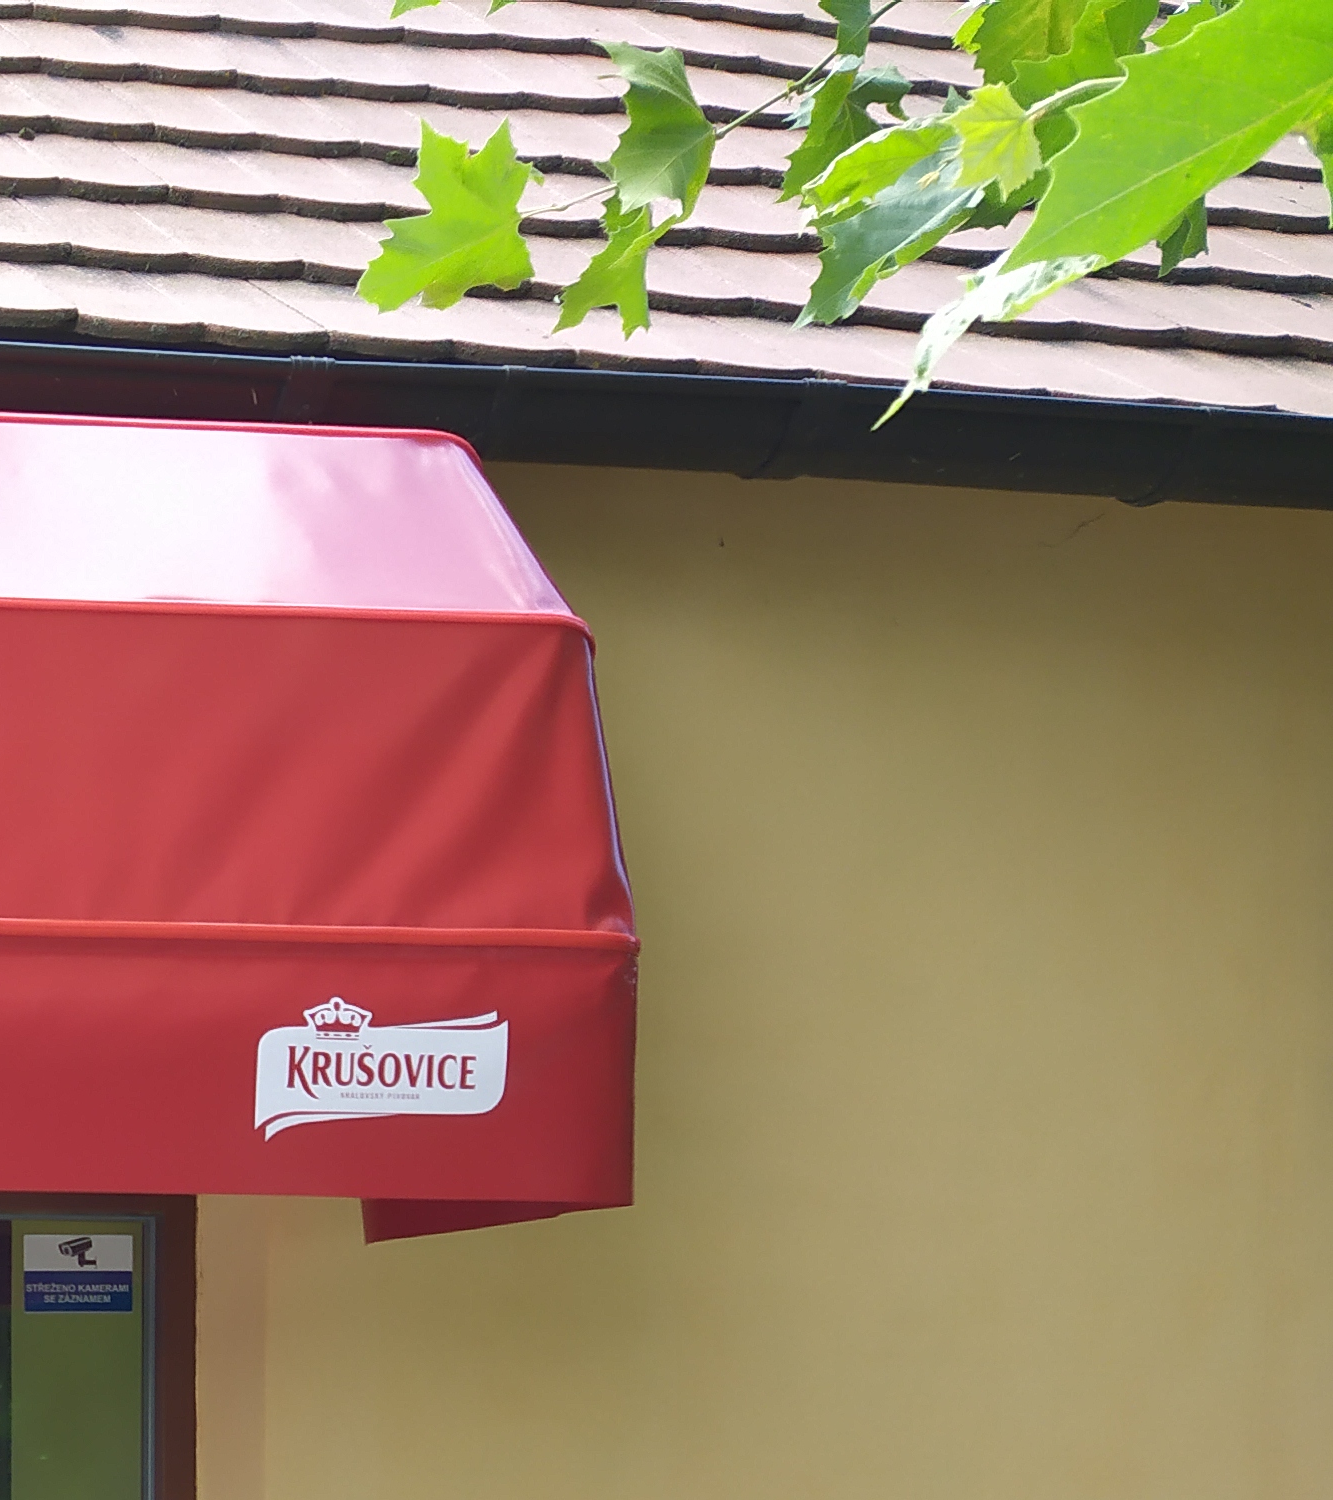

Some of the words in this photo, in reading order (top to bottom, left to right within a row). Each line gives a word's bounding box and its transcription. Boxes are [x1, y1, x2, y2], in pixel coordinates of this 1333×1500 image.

[286, 1044, 477, 1100] KRUŠOVICE
[77, 1283, 130, 1293] KAMERAMI
[43, 1294, 56, 1303] SE
